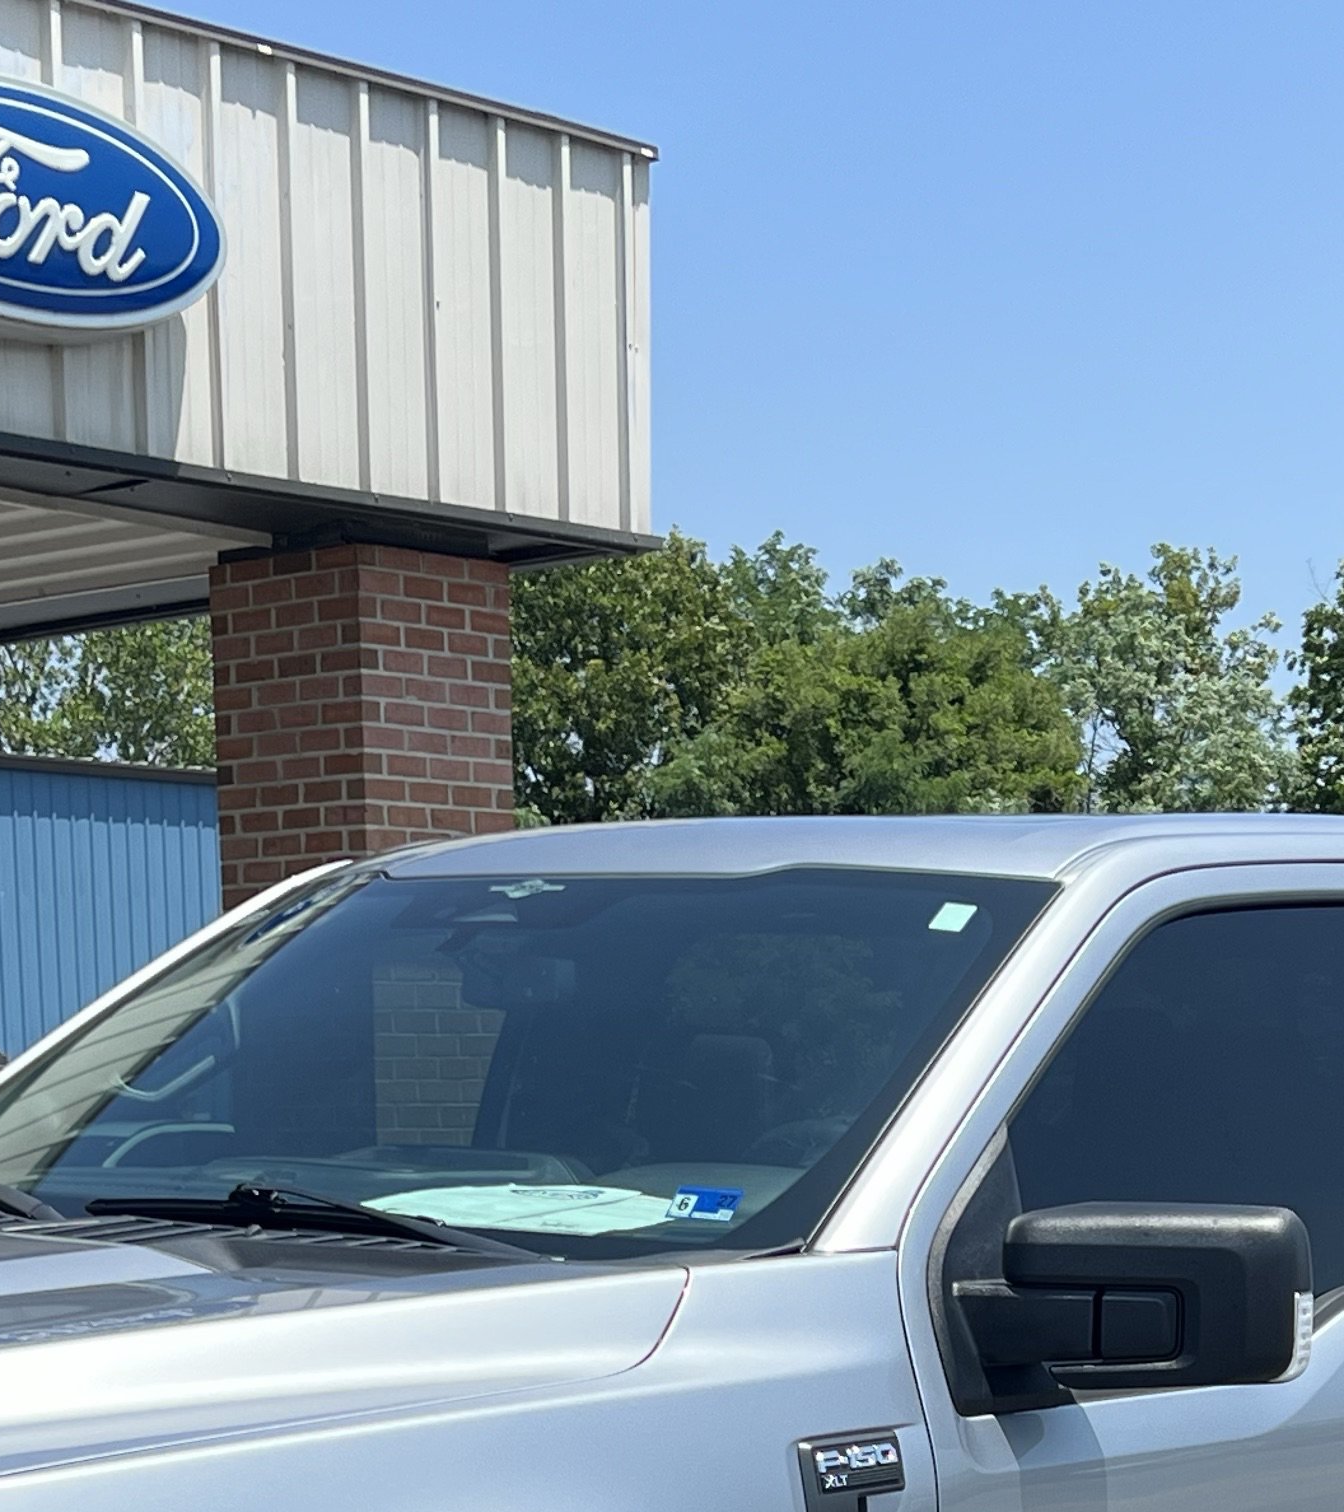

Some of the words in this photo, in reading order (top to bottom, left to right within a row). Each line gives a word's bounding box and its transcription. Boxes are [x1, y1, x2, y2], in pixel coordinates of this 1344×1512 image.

[678, 1197, 691, 1211] 6
[718, 1195, 738, 1208] 27
[816, 1443, 898, 1473] F-150
[822, 1474, 849, 1489] XLT
